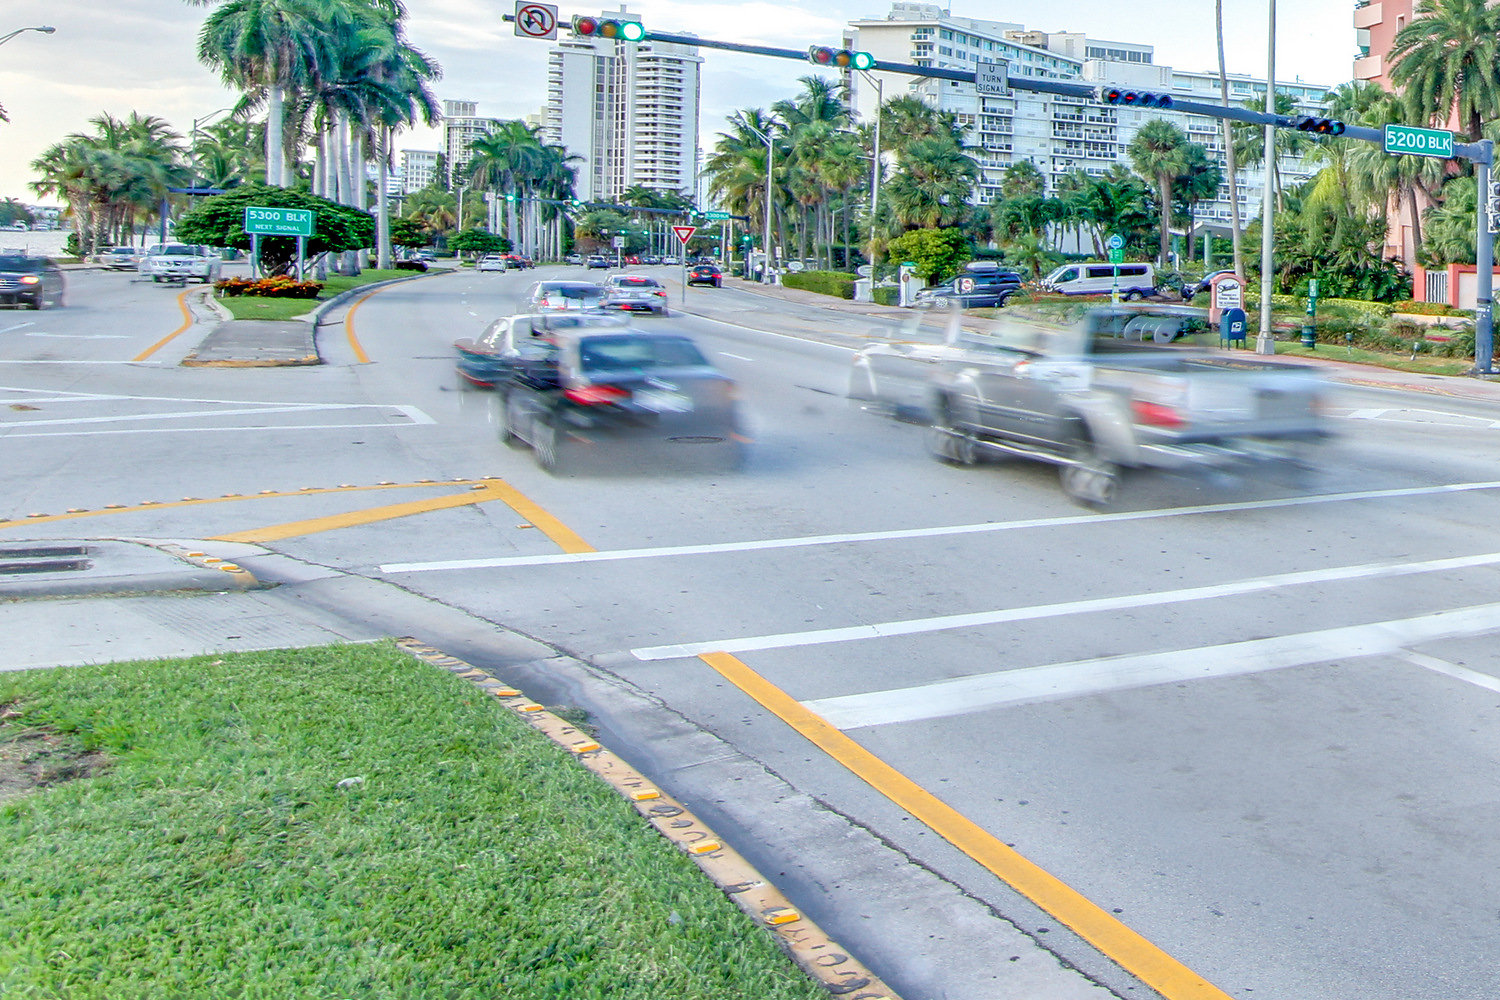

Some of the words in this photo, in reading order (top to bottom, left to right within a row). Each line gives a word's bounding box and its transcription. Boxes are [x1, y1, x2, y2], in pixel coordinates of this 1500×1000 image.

[982, 74, 1001, 83] TURN
[978, 84, 1005, 93] SIGNAL
[1387, 131, 1426, 149] 5200
[1428, 136, 1450, 151] BLK
[249, 210, 281, 221] 5300
[286, 212, 308, 223] BLK
